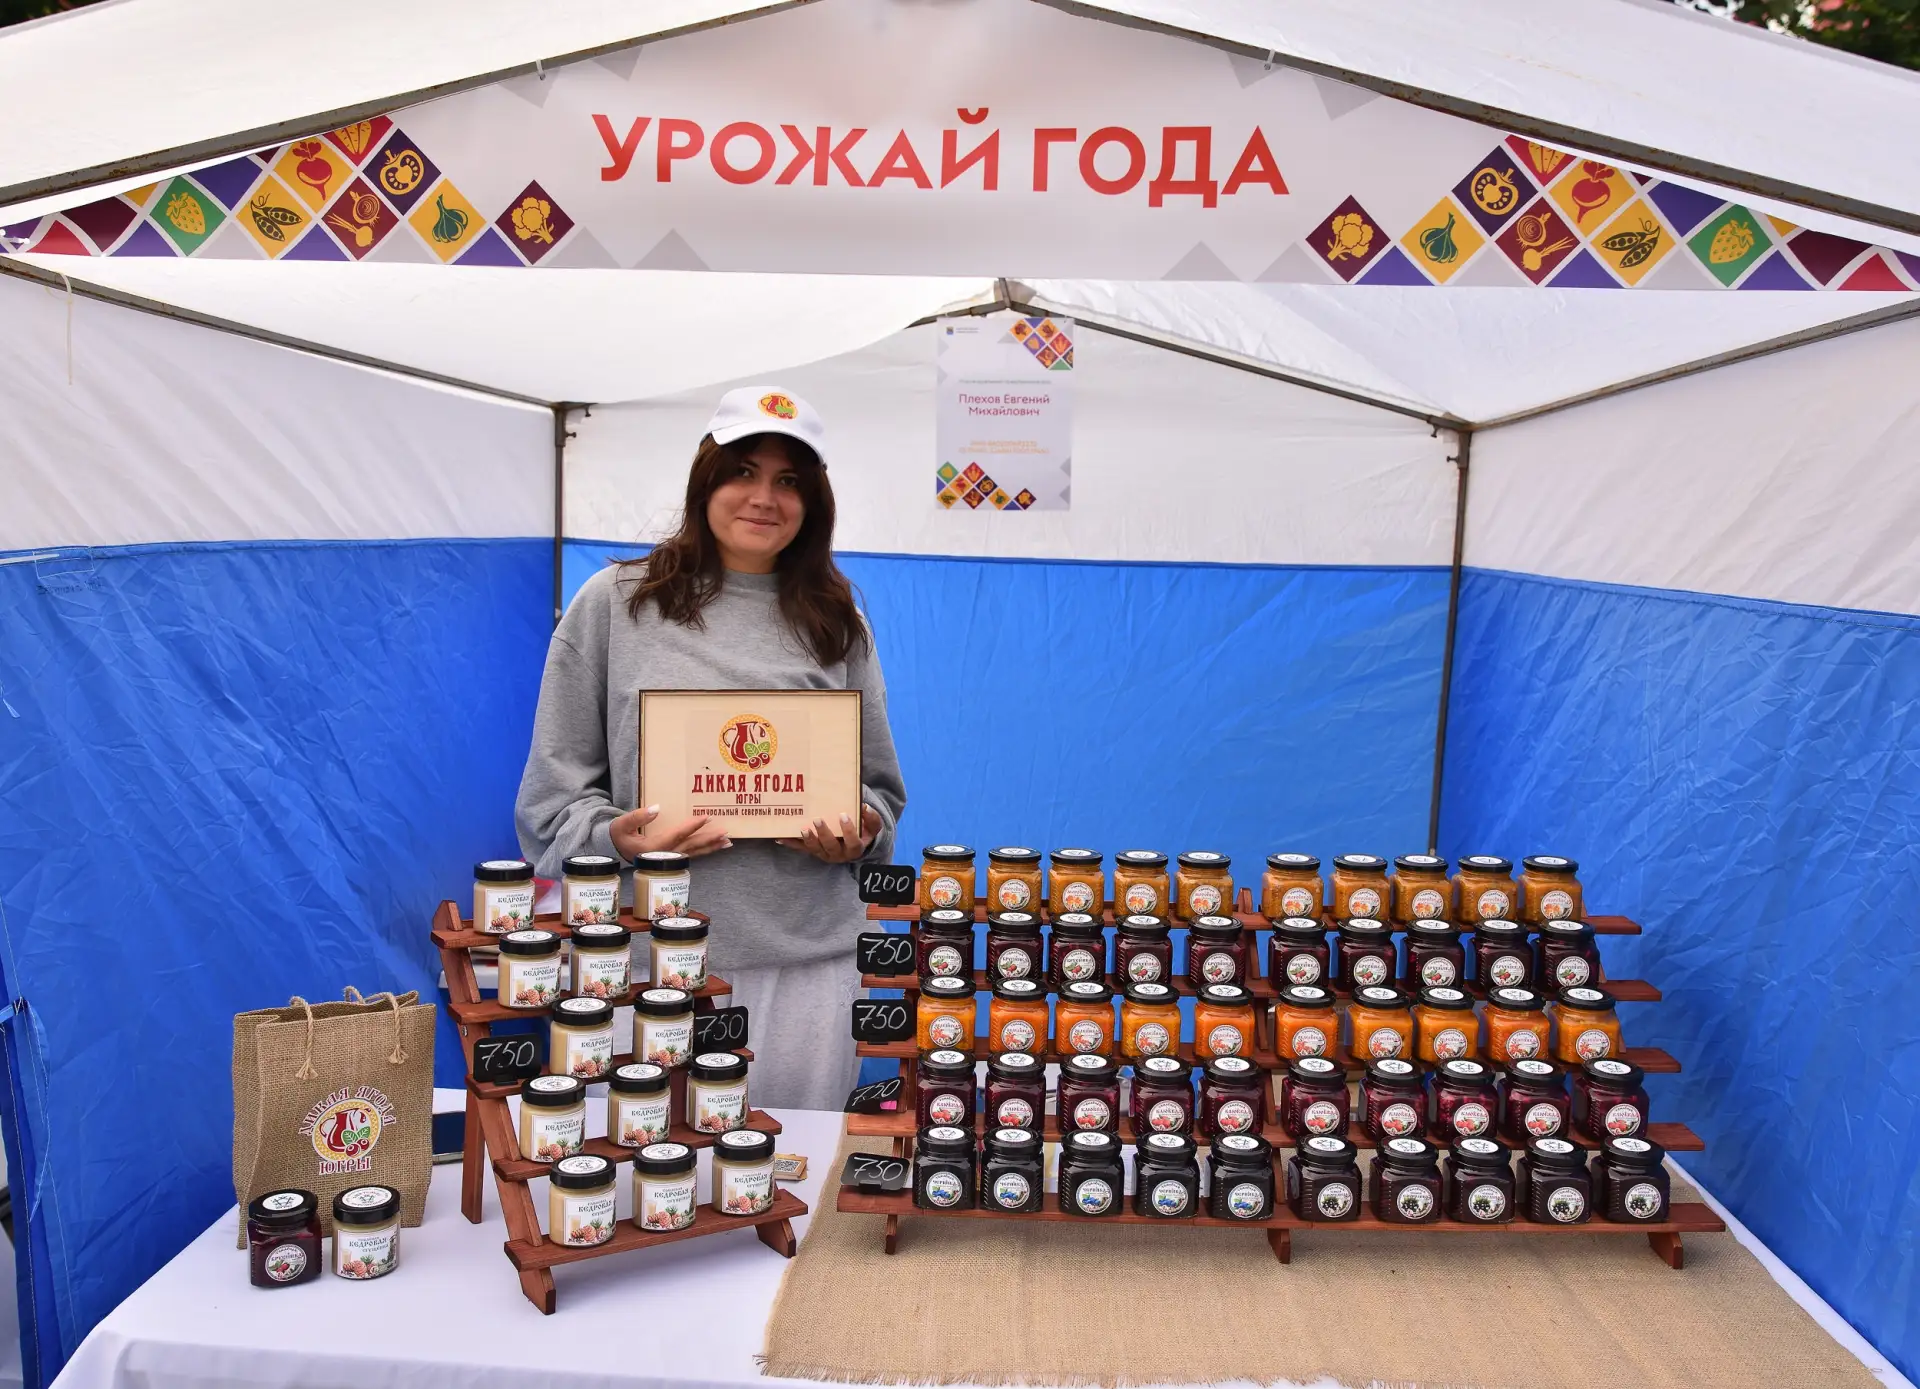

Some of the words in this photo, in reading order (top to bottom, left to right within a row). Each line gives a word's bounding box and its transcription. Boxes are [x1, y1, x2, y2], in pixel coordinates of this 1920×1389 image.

[591, 107, 1000, 191] УРОЖАЙ
[1032, 125, 1290, 208] ГОДА
[958, 394, 1001, 404] Плехов
[1003, 394, 1050, 404] Евгений
[968, 406, 1040, 416] Михайлович
[691, 774, 746, 793] ДИКАЯ
[754, 774, 805, 793] ЯГОДА
[735, 794, 761, 804] ЮГРЫ
[863, 872, 910, 893] 1200
[861, 937, 912, 965] 750
[696, 1013, 745, 1043] 750
[856, 1004, 907, 1031] 750
[478, 1041, 535, 1071] 750
[851, 1079, 901, 1106] 750
[298, 1086, 350, 1137] ДИКАЯ
[354, 1085, 397, 1127] ЯГОДА
[319, 1156, 372, 1176] ЮГРЫ
[853, 1156, 904, 1182] 750
